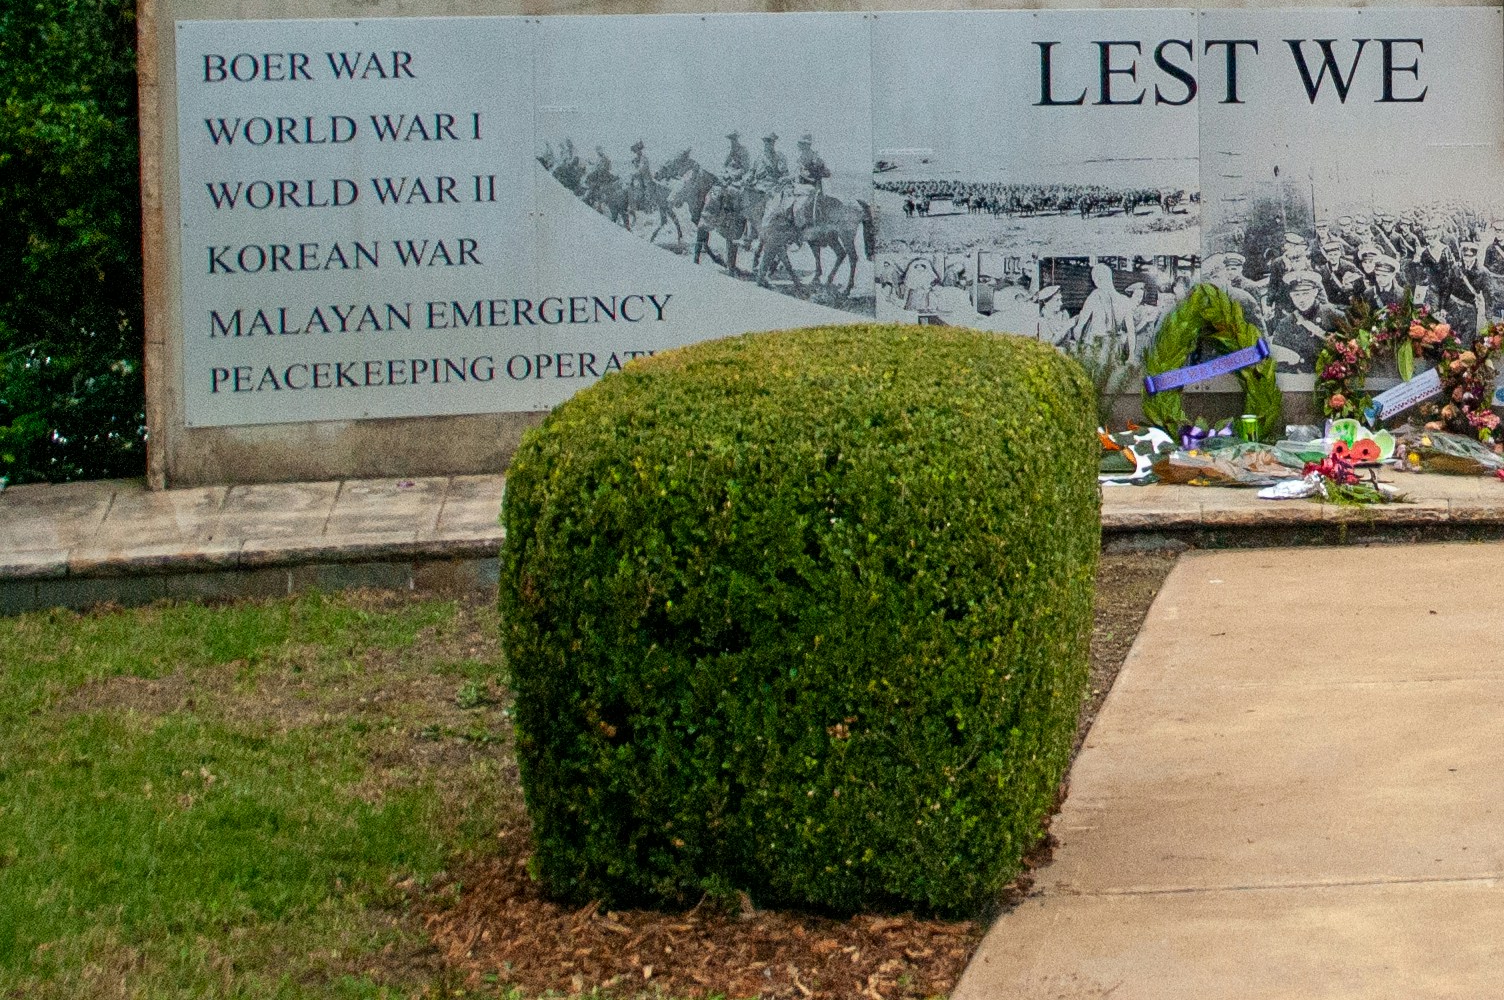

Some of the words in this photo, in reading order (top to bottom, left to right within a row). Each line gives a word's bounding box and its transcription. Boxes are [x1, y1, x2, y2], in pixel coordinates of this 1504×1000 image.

[203, 52, 313, 83] BOER
[325, 50, 416, 80] WAR
[1031, 38, 1259, 107] LEST
[1284, 37, 1430, 105] WE
[204, 115, 358, 146] WORLD
[369, 113, 459, 142] WAR
[471, 112, 482, 140] I
[205, 178, 359, 210] WORLD
[371, 176, 460, 205] WAR
[473, 174, 497, 203] II
[208, 241, 379, 275] KOREAN
[392, 238, 482, 267] WAR
[210, 302, 412, 339] MALAYAN
[426, 293, 673, 330] EMERGENCY
[211, 356, 495, 394] PEACEKEEPING
